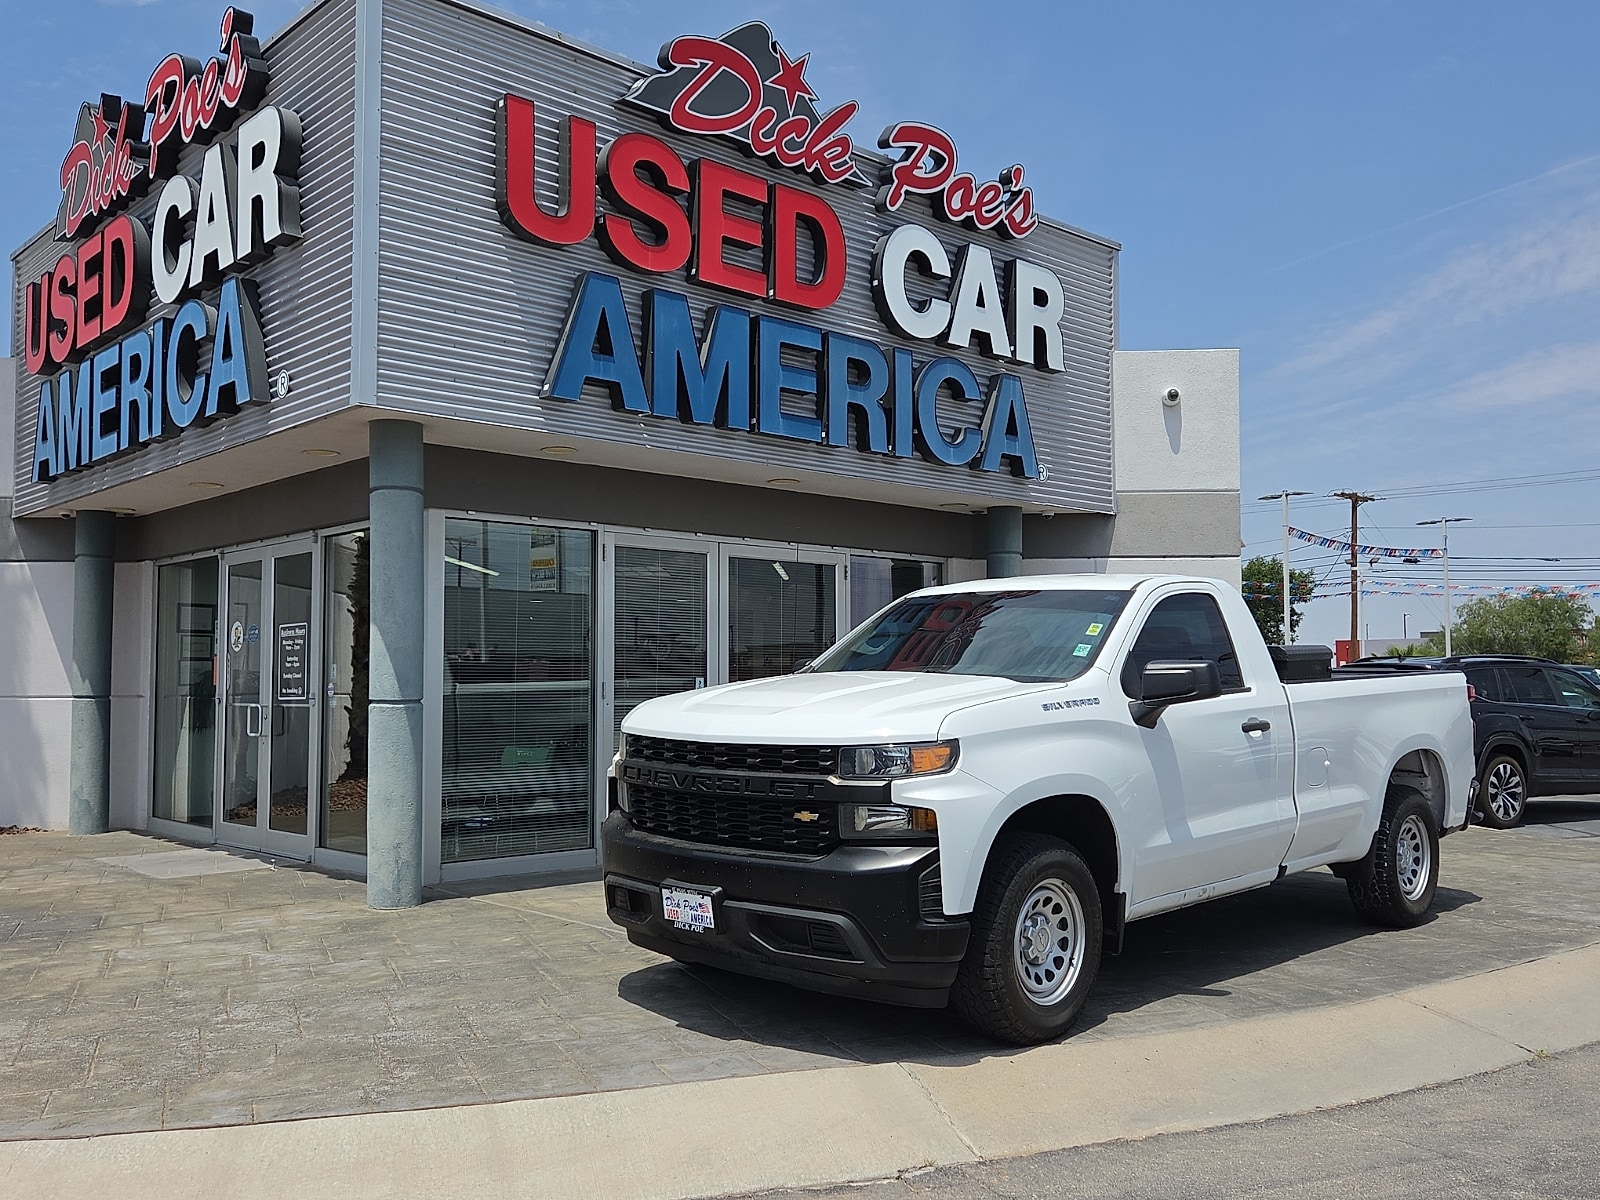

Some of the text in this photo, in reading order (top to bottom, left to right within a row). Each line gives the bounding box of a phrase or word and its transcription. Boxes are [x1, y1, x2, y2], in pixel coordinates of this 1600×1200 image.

[61, 5, 249, 239] Dick Poe's
[668, 34, 1040, 240] Dick Poe's
[25, 106, 283, 375] USED CAR
[503, 93, 1067, 373] USED CAR
[31, 276, 251, 483] AMERICA
[548, 271, 1040, 482] AMERICA
[623, 765, 825, 798] CHEVROLET
[1041, 697, 1100, 711] SILVERADO
[665, 896, 681, 909] Dick
[666, 908, 680, 920] USED
[690, 912, 713, 926] AMERICA
[674, 921, 706, 933] DICK POE
